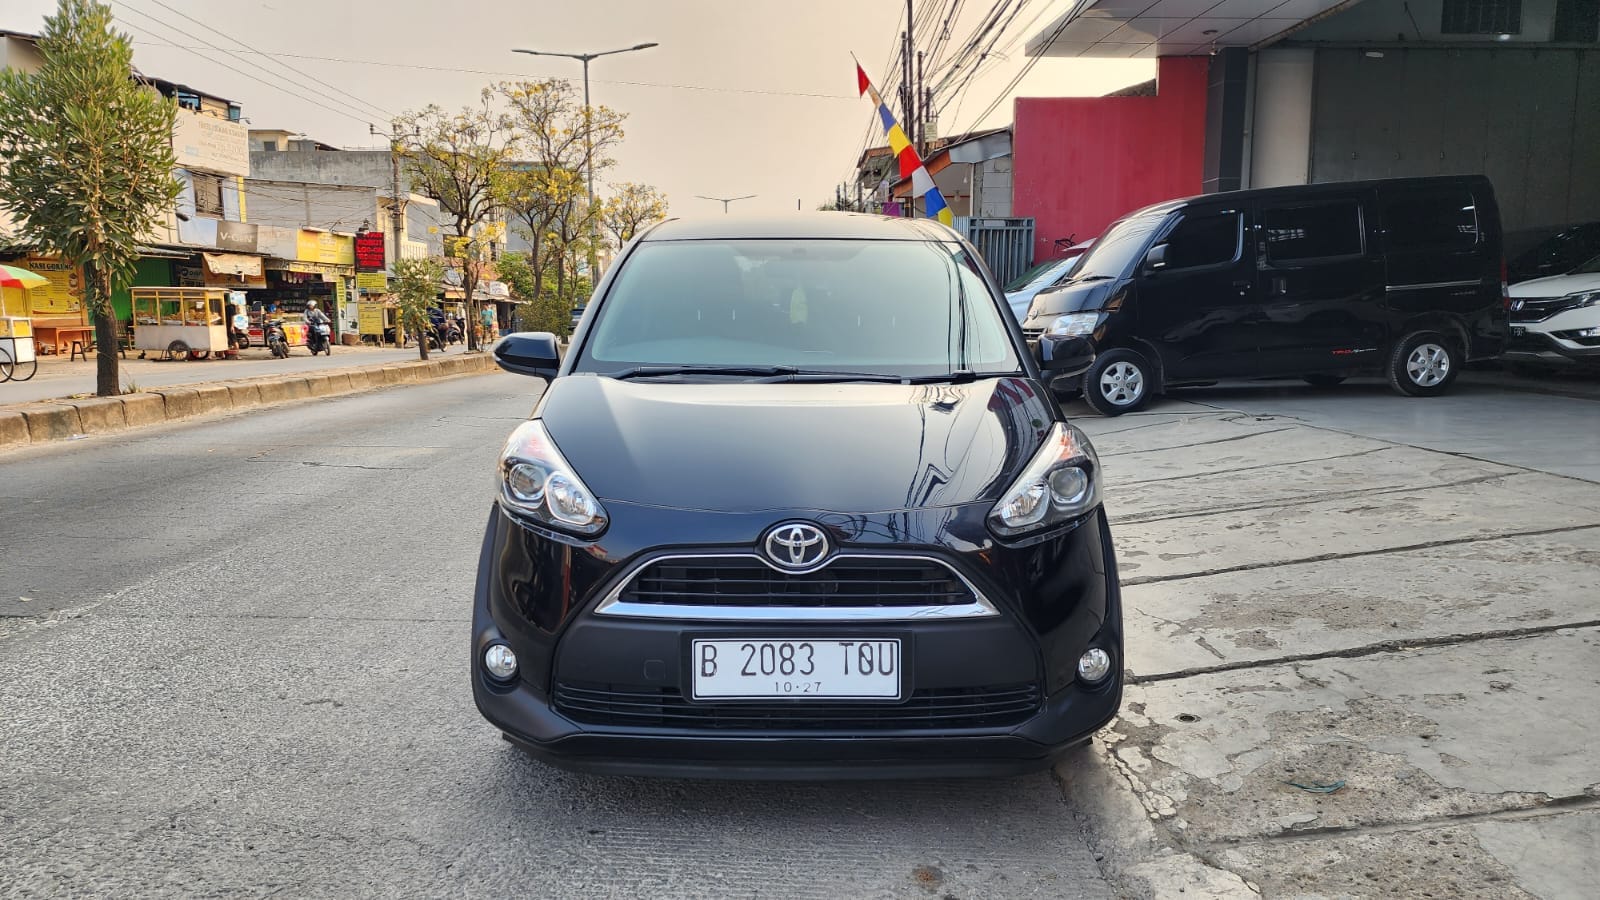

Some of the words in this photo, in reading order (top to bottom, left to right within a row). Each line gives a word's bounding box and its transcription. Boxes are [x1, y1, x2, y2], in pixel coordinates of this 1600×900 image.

[29, 262, 46, 270] NASI
[47, 263, 74, 271] GORENG
[701, 644, 718, 677] B
[741, 642, 815, 677] 2083
